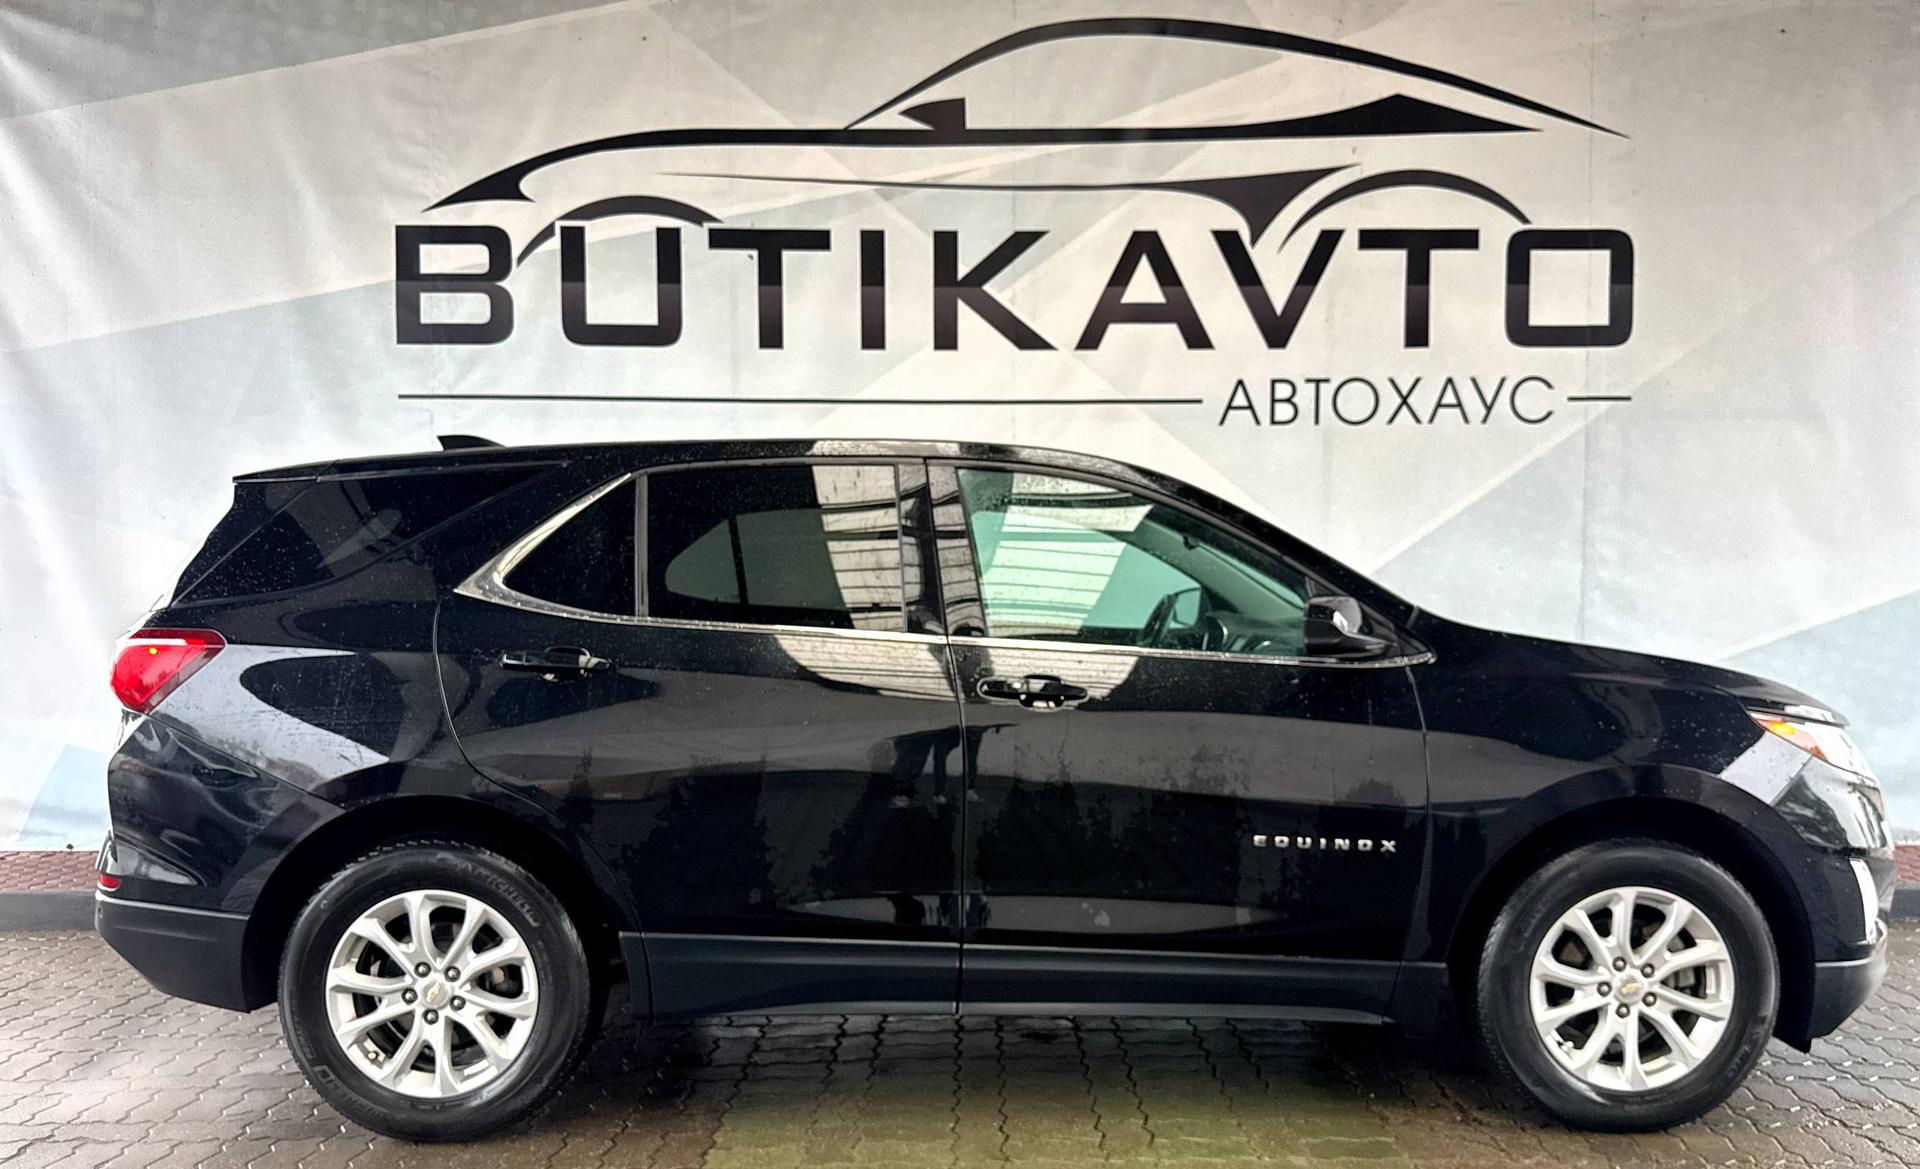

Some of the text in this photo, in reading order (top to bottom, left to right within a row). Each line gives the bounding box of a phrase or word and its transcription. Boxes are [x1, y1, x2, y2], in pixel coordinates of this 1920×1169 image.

[396, 225, 1634, 351] BUTIKAVTO
[1219, 376, 1553, 426] АВТОХАУС
[1252, 834, 1397, 853] EQUINOX
